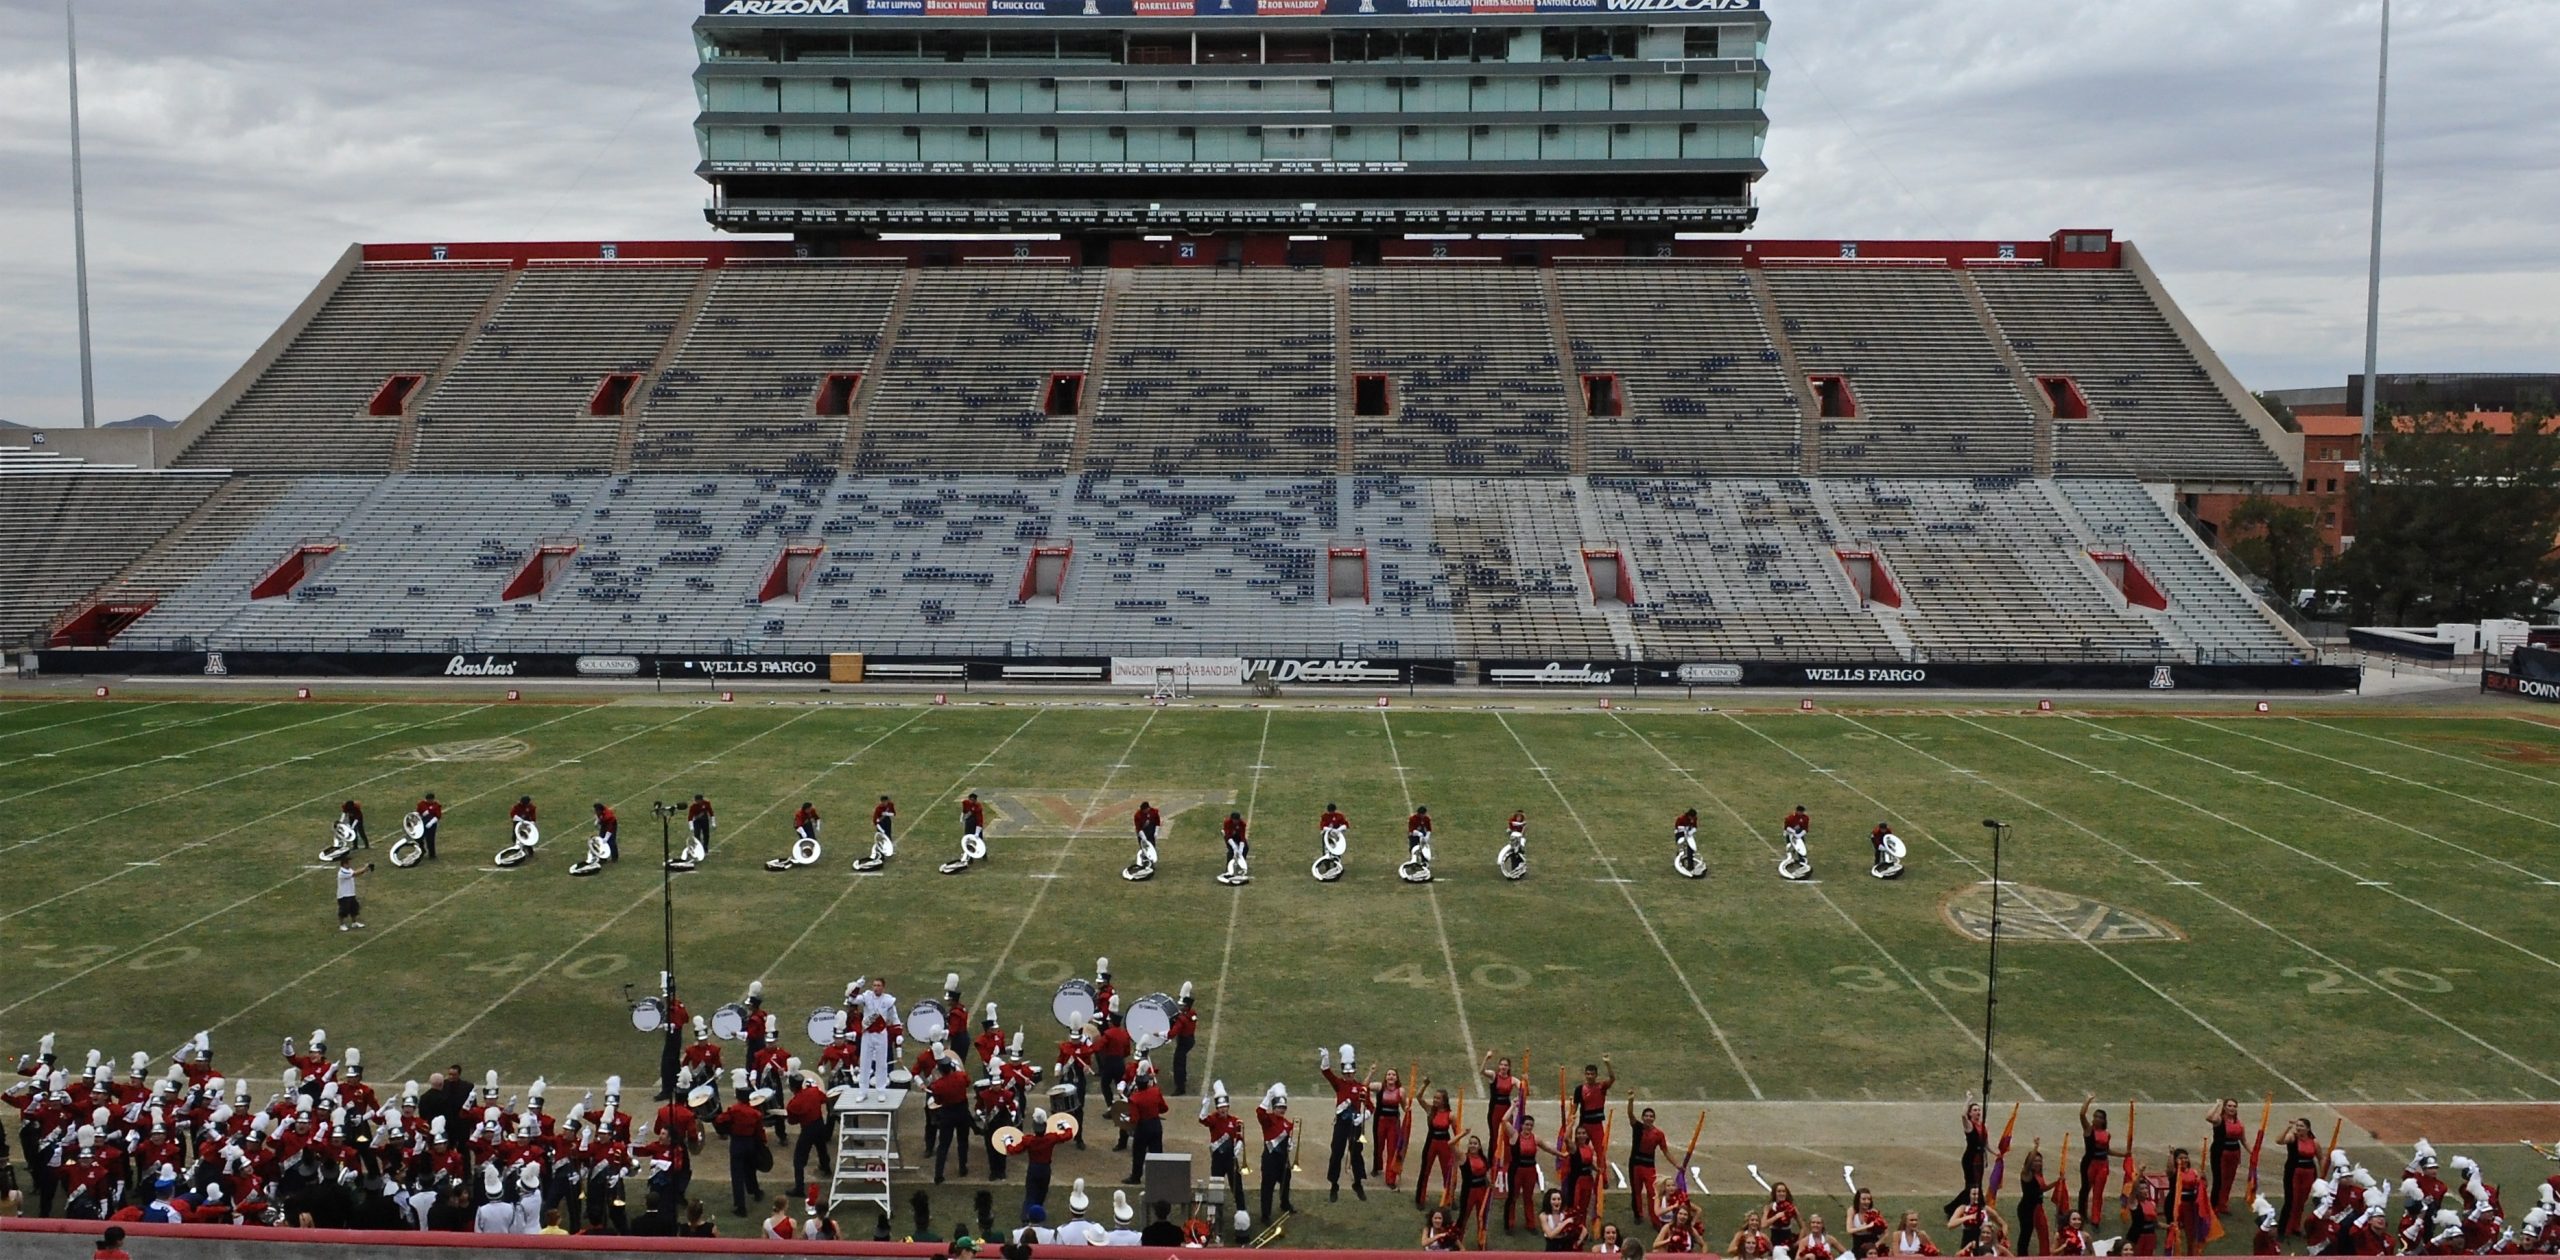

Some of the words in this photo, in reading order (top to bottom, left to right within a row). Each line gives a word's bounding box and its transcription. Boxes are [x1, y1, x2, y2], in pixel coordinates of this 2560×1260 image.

[719, 0, 849, 14] ARIZONA
[876, 1, 890, 9] ART
[890, 1, 922, 9] LUPPINO
[936, 1, 957, 9] RICKY
[958, 1, 986, 9] HUNLEY
[998, 2, 1024, 10] CHUCK
[1025, 2, 1045, 10] CECIL
[1139, 2, 1171, 10] DARRYLL
[1172, 2, 1194, 10] LEWIS
[1268, 0, 1283, 8] ROB
[1283, 0, 1319, 8] WALDROP
[434, 250, 446, 259] 17
[602, 249, 615, 259] 18
[796, 248, 808, 259] 19
[1014, 248, 1029, 257] 20
[1181, 246, 1195, 257] 21
[1432, 247, 1447, 257] 22
[1657, 247, 1671, 257] 23
[1841, 249, 1855, 259] 24
[2000, 249, 2014, 259] 25
[33, 434, 44, 443] 16
[444, 655, 517, 676] Bashas'
[581, 660, 600, 669] SOL
[600, 660, 635, 669] CASINOS
[700, 661, 757, 673] WELLS
[761, 661, 816, 673] FARGO
[1114, 664, 1154, 676] UNIVERSITY
[1200, 664, 1222, 676] BAND
[1223, 664, 1238, 676] DAY
[1681, 668, 1699, 676] SOL
[1701, 668, 1737, 677] CASINOS
[1805, 668, 1865, 681] WELLS
[1868, 668, 1926, 681] FARGO
[2519, 680, 2560, 699] DOWN
[1372, 963, 1533, 990] 40
[1830, 965, 1991, 993] 30
[2280, 965, 2454, 995] 20
